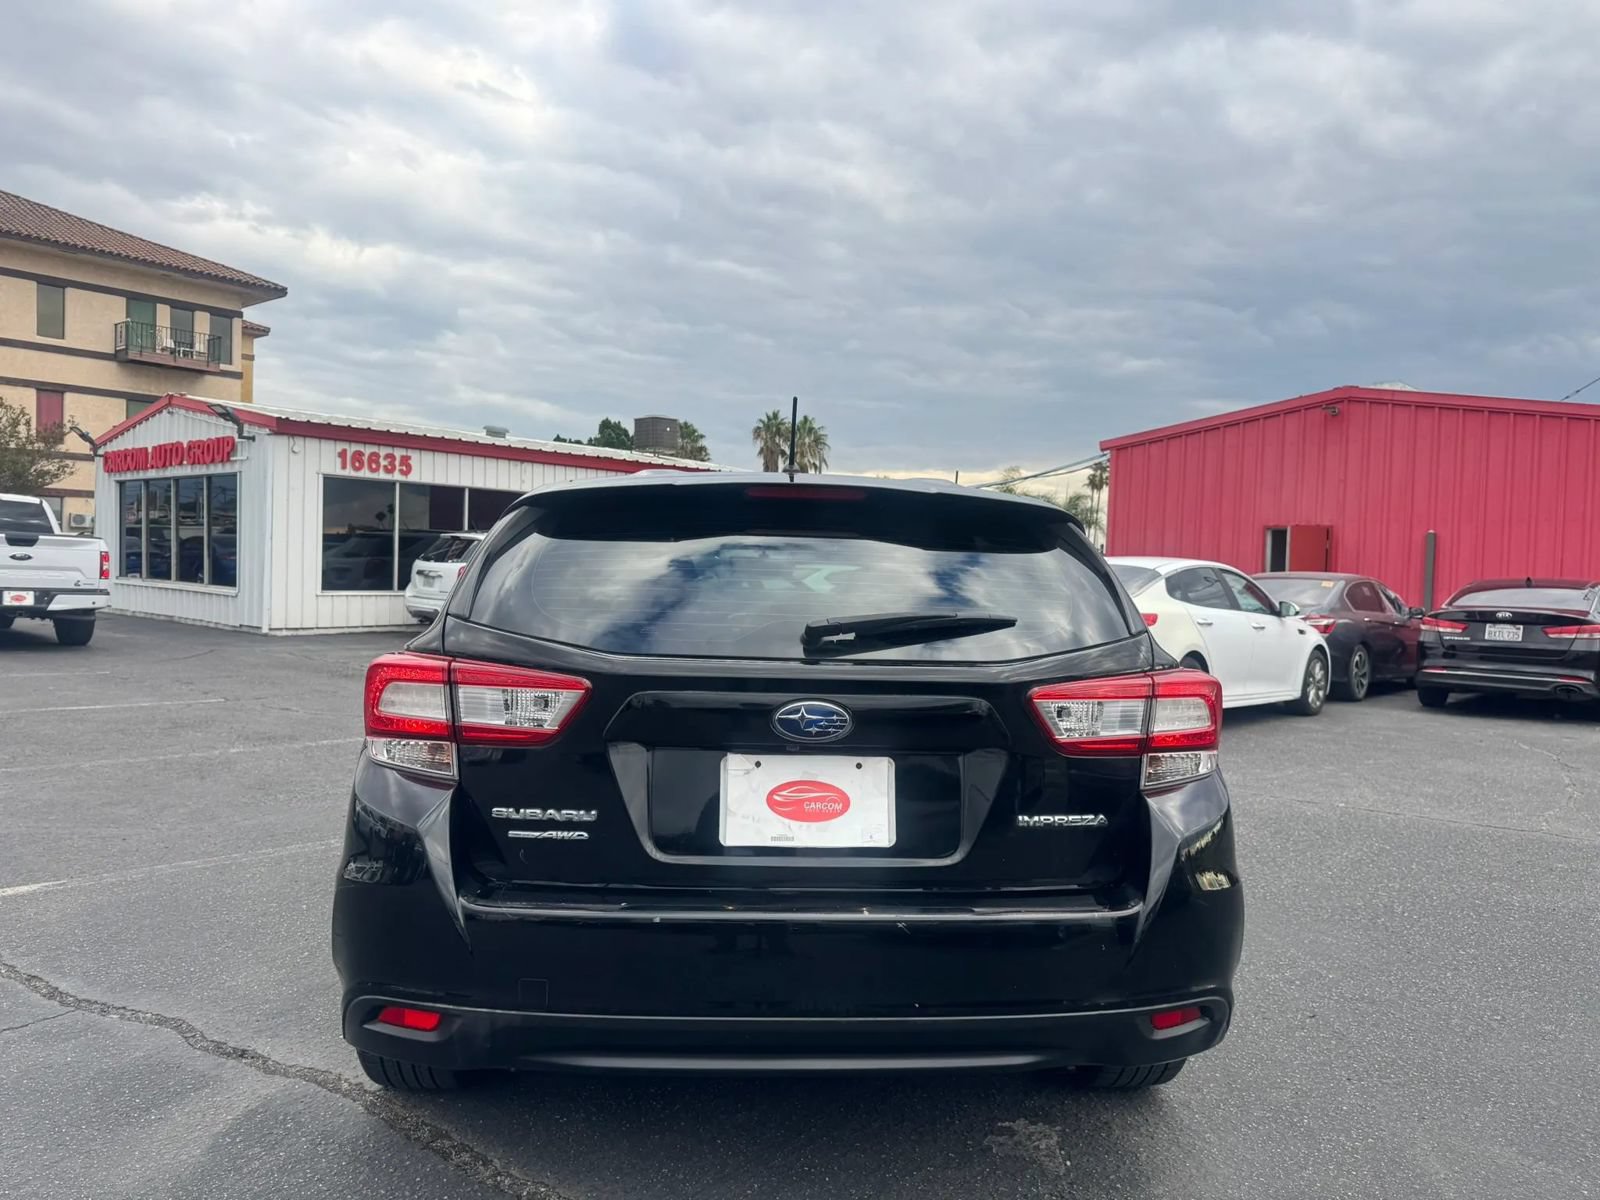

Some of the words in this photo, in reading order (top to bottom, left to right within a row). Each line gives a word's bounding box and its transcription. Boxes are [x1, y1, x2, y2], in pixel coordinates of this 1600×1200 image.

[149, 441, 184, 469] AUTO
[185, 435, 236, 465] GROUP
[337, 448, 412, 476] 16635
[803, 801, 843, 810] CARCOM
[491, 807, 597, 821] SUBARU
[1017, 813, 1108, 826] IMPREZA
[538, 831, 590, 840] AWD
